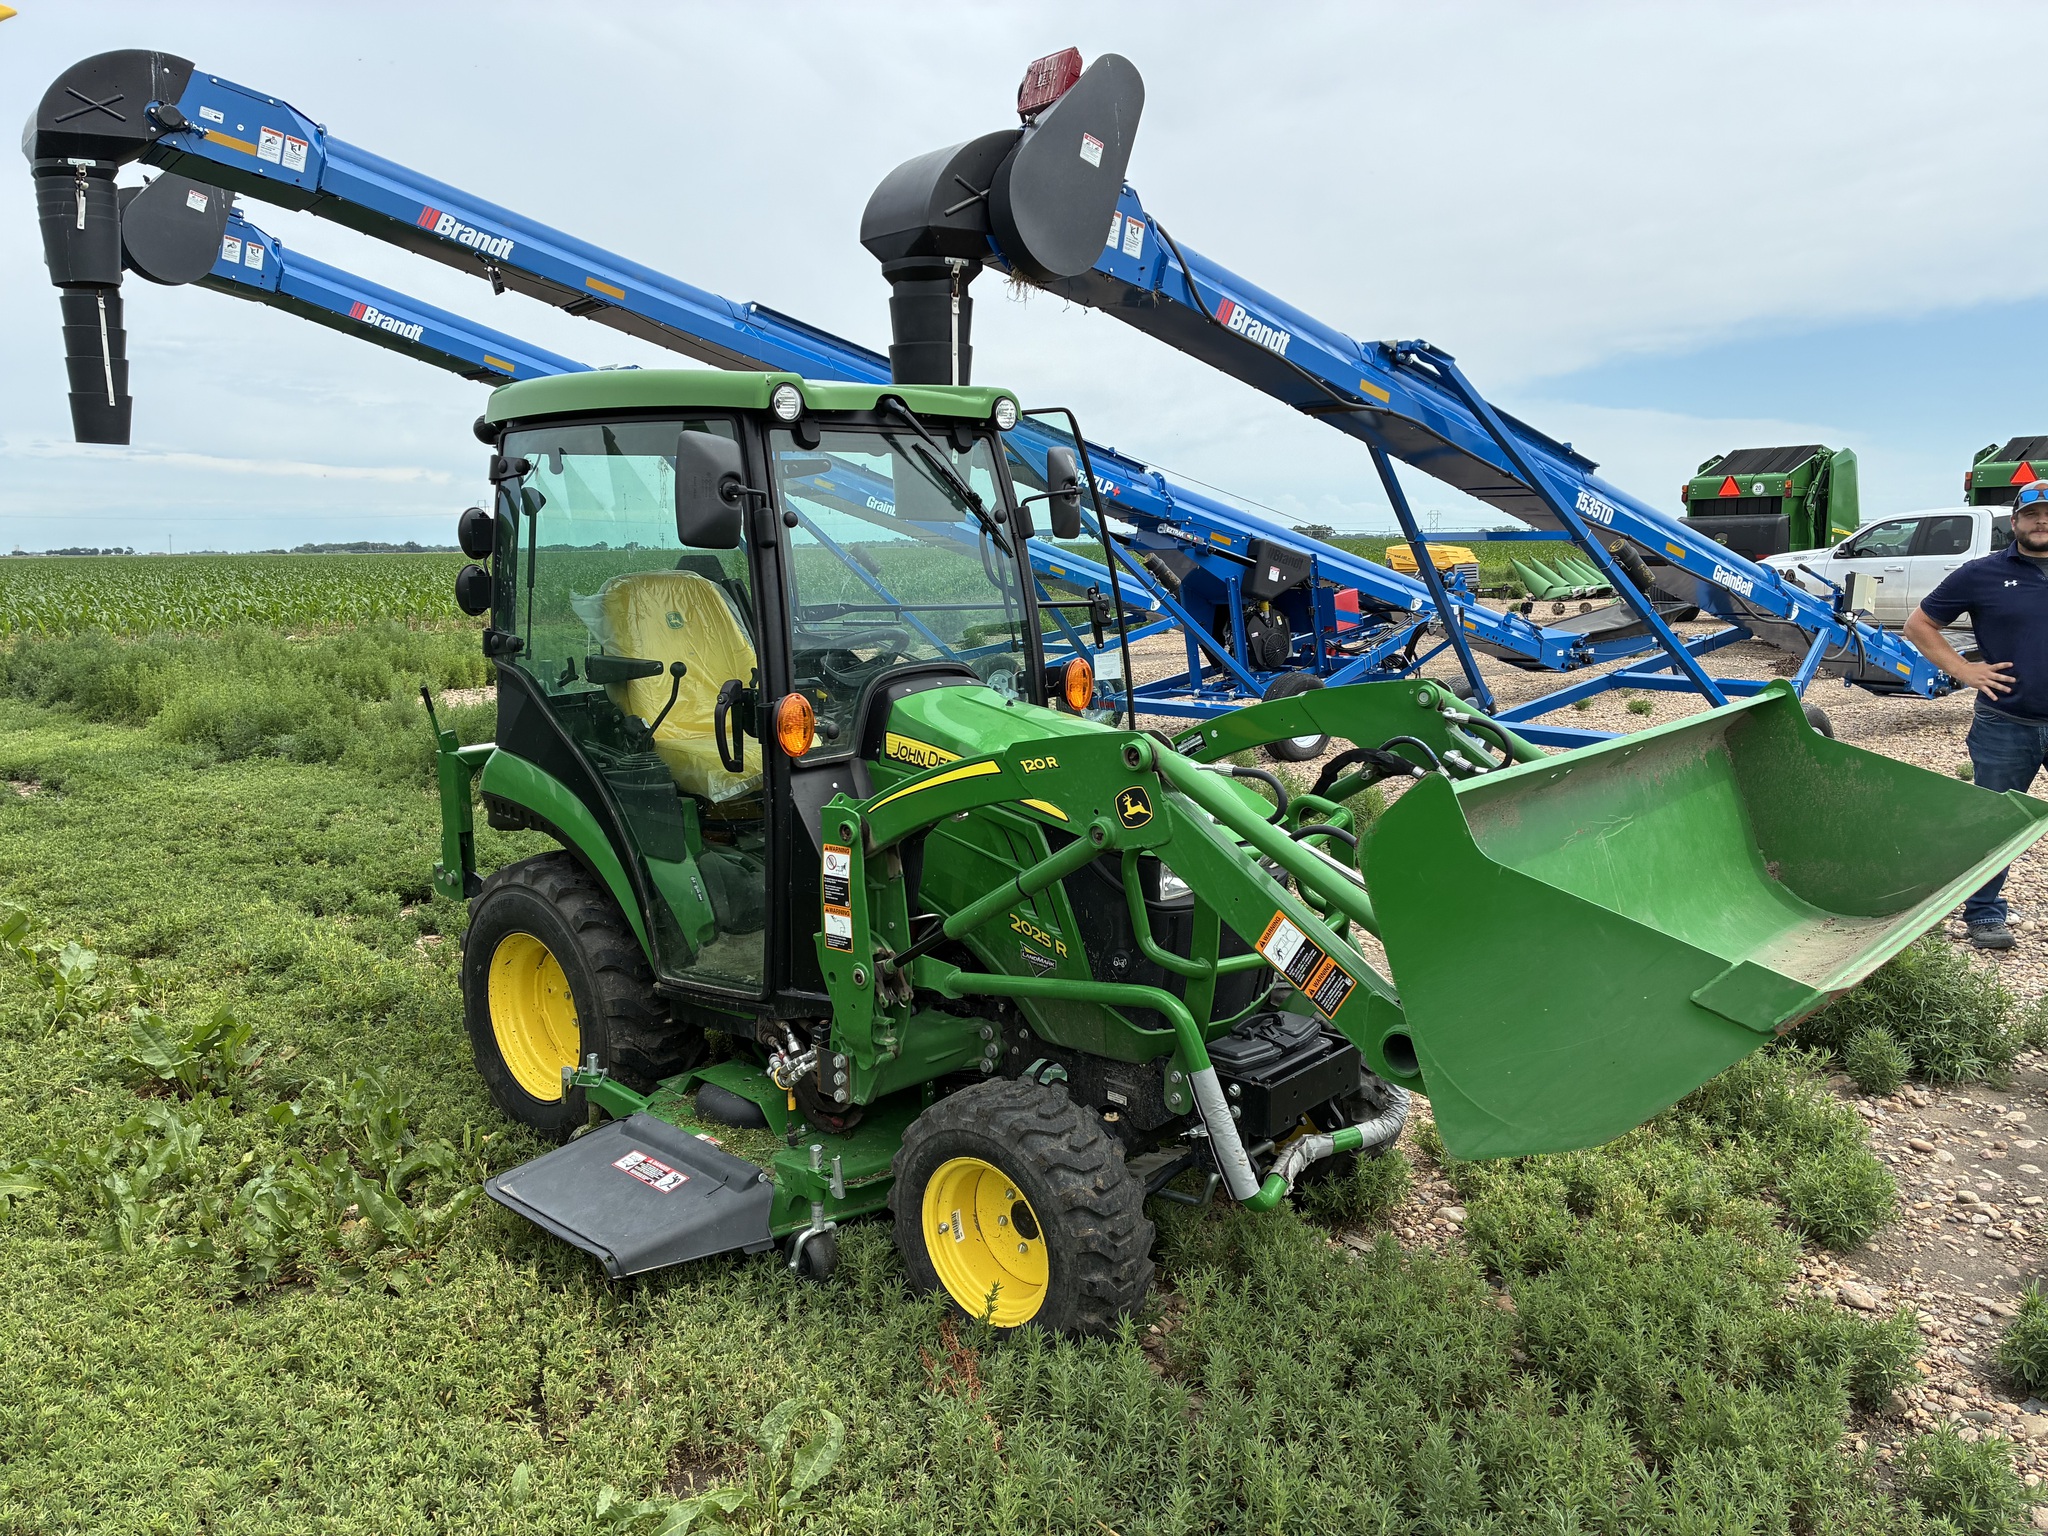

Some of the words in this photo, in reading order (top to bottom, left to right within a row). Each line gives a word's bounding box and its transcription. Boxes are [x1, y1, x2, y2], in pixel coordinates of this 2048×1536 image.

[433, 212, 515, 260] Brandt
[361, 305, 424, 342] Brandt
[1227, 304, 1291, 356] Brandt
[1575, 491, 1615, 525] 1535TD
[1712, 564, 1754, 598] GrainBelt
[892, 741, 927, 764] JOHN
[928, 750, 953, 767] DE
[1020, 757, 1046, 774] 120
[1045, 756, 1059, 769] R
[828, 845, 850, 855] WARNING
[1008, 913, 1052, 948] 2025
[1054, 939, 1068, 959] R
[1263, 916, 1281, 942] WARNING
[1313, 962, 1332, 988] WARNING
